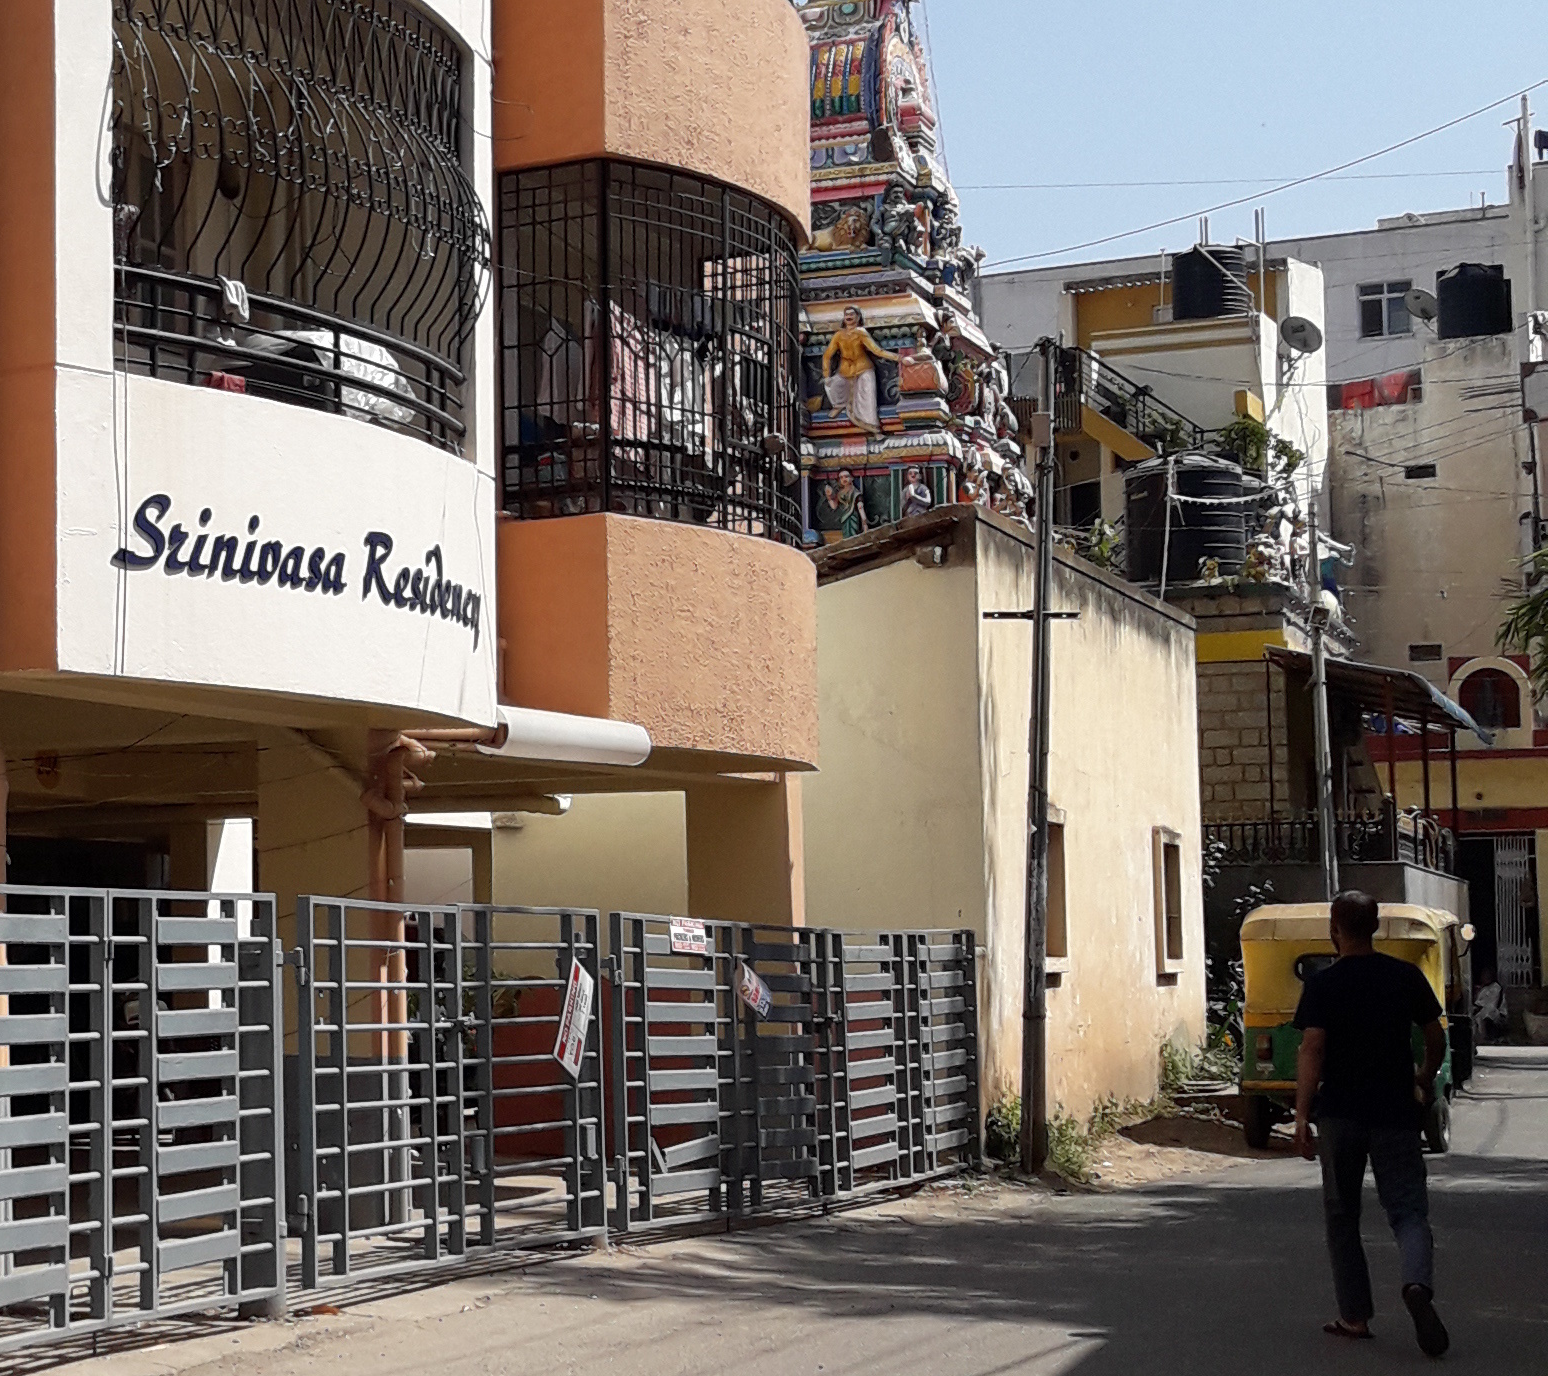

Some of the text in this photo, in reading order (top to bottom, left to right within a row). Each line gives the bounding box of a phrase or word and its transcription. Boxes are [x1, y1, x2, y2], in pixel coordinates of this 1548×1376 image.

[110, 494, 481, 652] Srinivasa Residency
[566, 981, 578, 1026] PARKING
